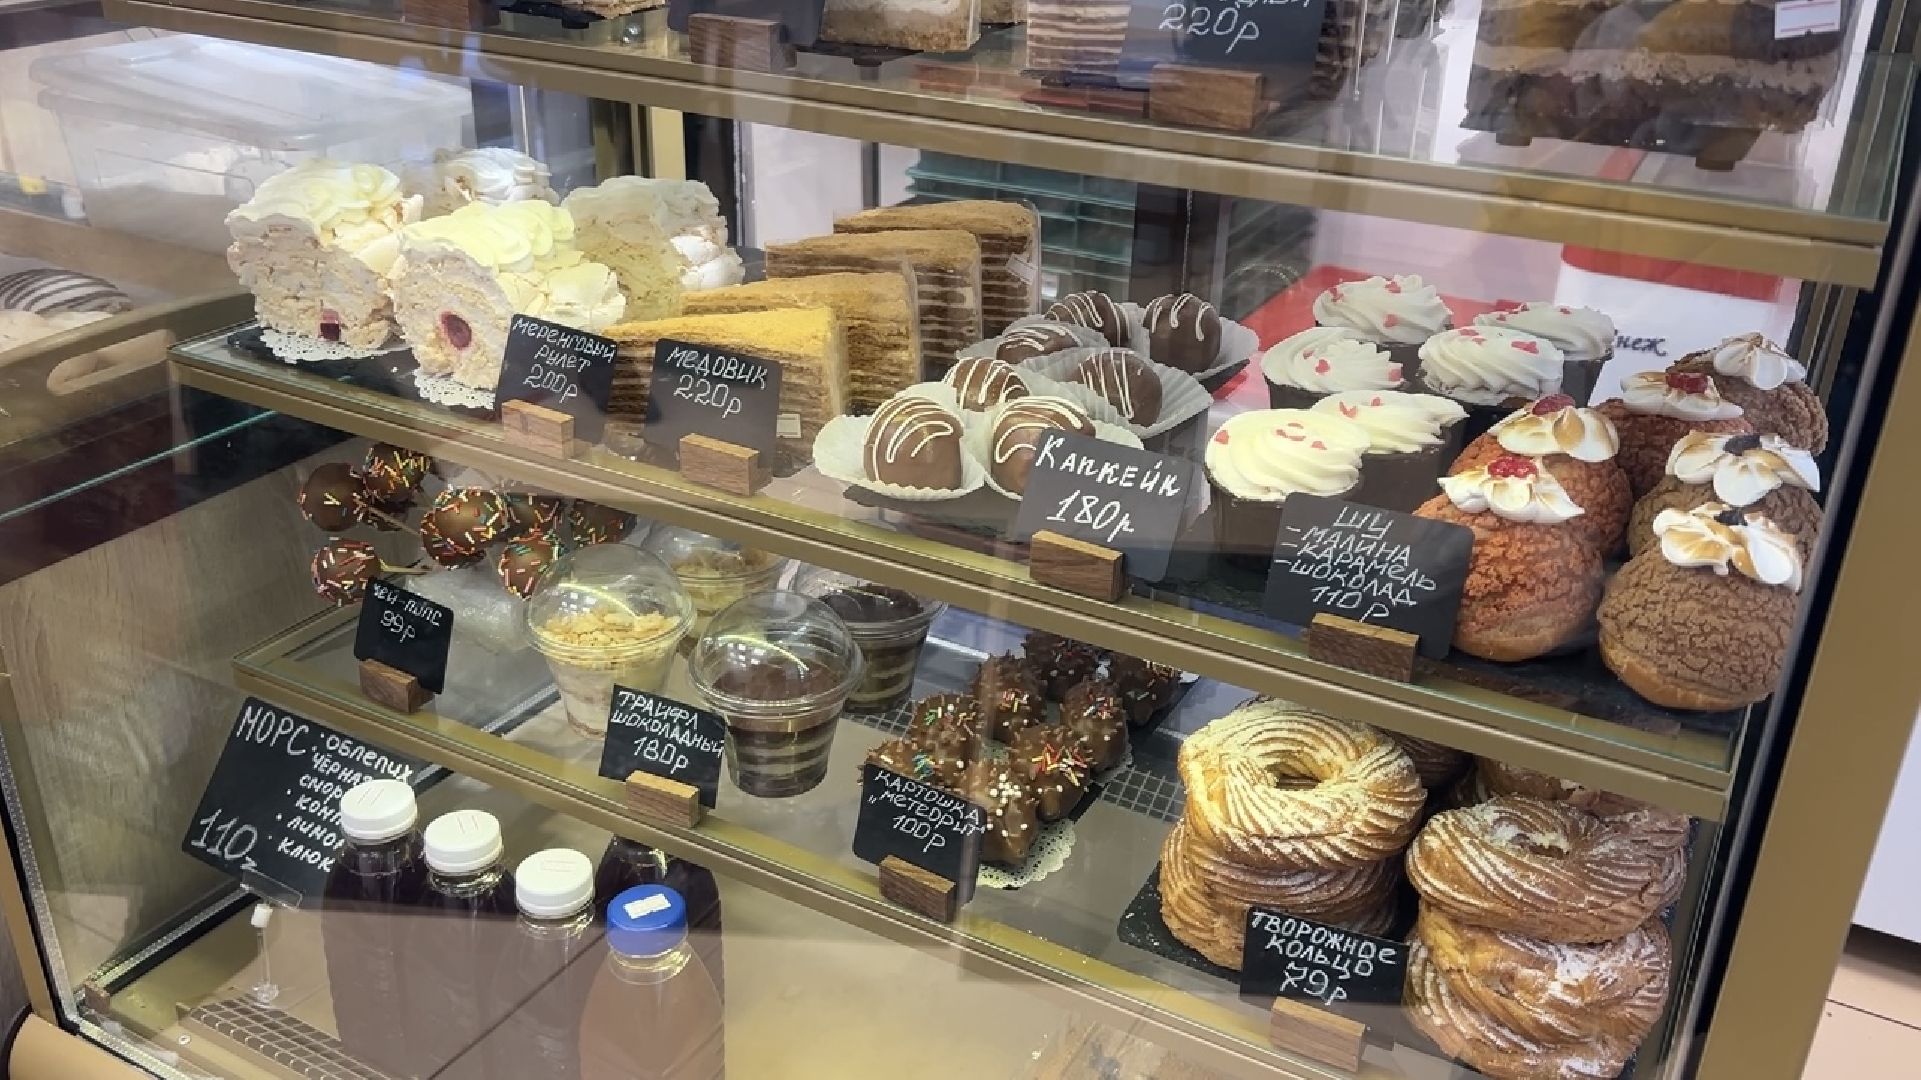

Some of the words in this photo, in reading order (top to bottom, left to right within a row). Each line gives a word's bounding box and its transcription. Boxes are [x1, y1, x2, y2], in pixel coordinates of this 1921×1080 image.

[534, 345, 590, 372] РУЛЕТ
[665, 346, 768, 390] МЕДОВИК
[1333, 506, 1394, 540] ШУ
[236, 706, 309, 755] МОРС
[610, 709, 725, 759] ШОКОЛАДНЫЙ
[874, 770, 979, 825] КАРТОШКА
[1251, 911, 1396, 965] ТВОРОЖНОЕ
[1264, 934, 1374, 980] КОЛЬЦО
